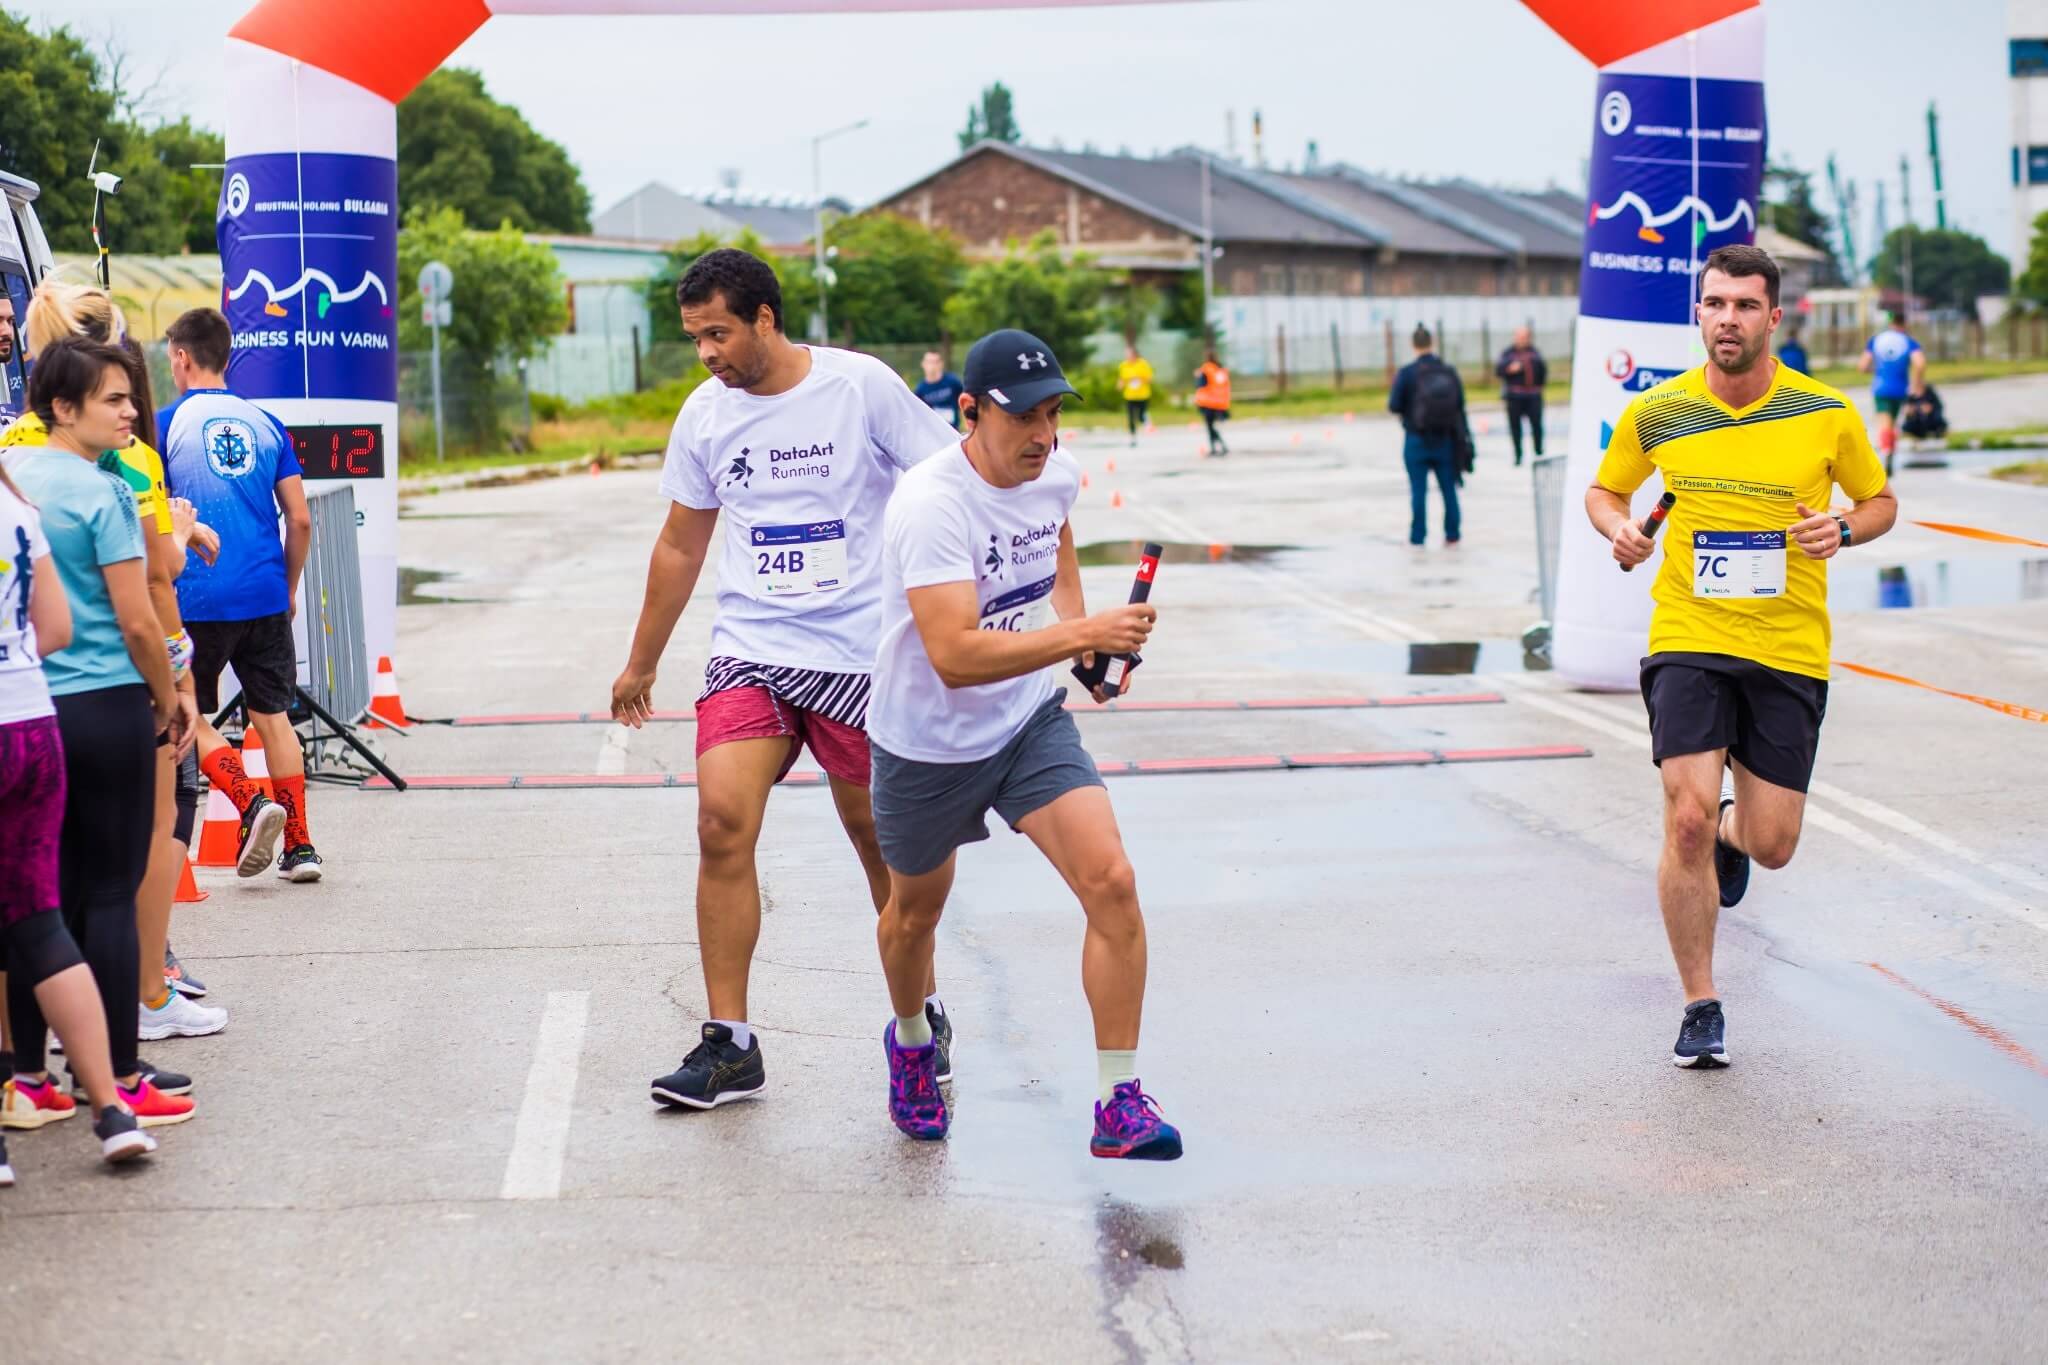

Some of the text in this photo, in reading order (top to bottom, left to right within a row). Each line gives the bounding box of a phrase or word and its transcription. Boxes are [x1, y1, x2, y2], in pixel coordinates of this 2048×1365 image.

[254, 198, 389, 217] INDUSTRIAL HOLDING BULGARIA
[231, 331, 389, 349] USINESS RUN VARNA
[1644, 388, 1688, 405] uhlsport
[769, 442, 834, 462] DataArt
[771, 463, 831, 480] Running
[1716, 482, 1737, 491] Many
[1012, 520, 1057, 548] DataArt
[757, 550, 805, 575] 24B
[1698, 555, 1729, 578] 7C
